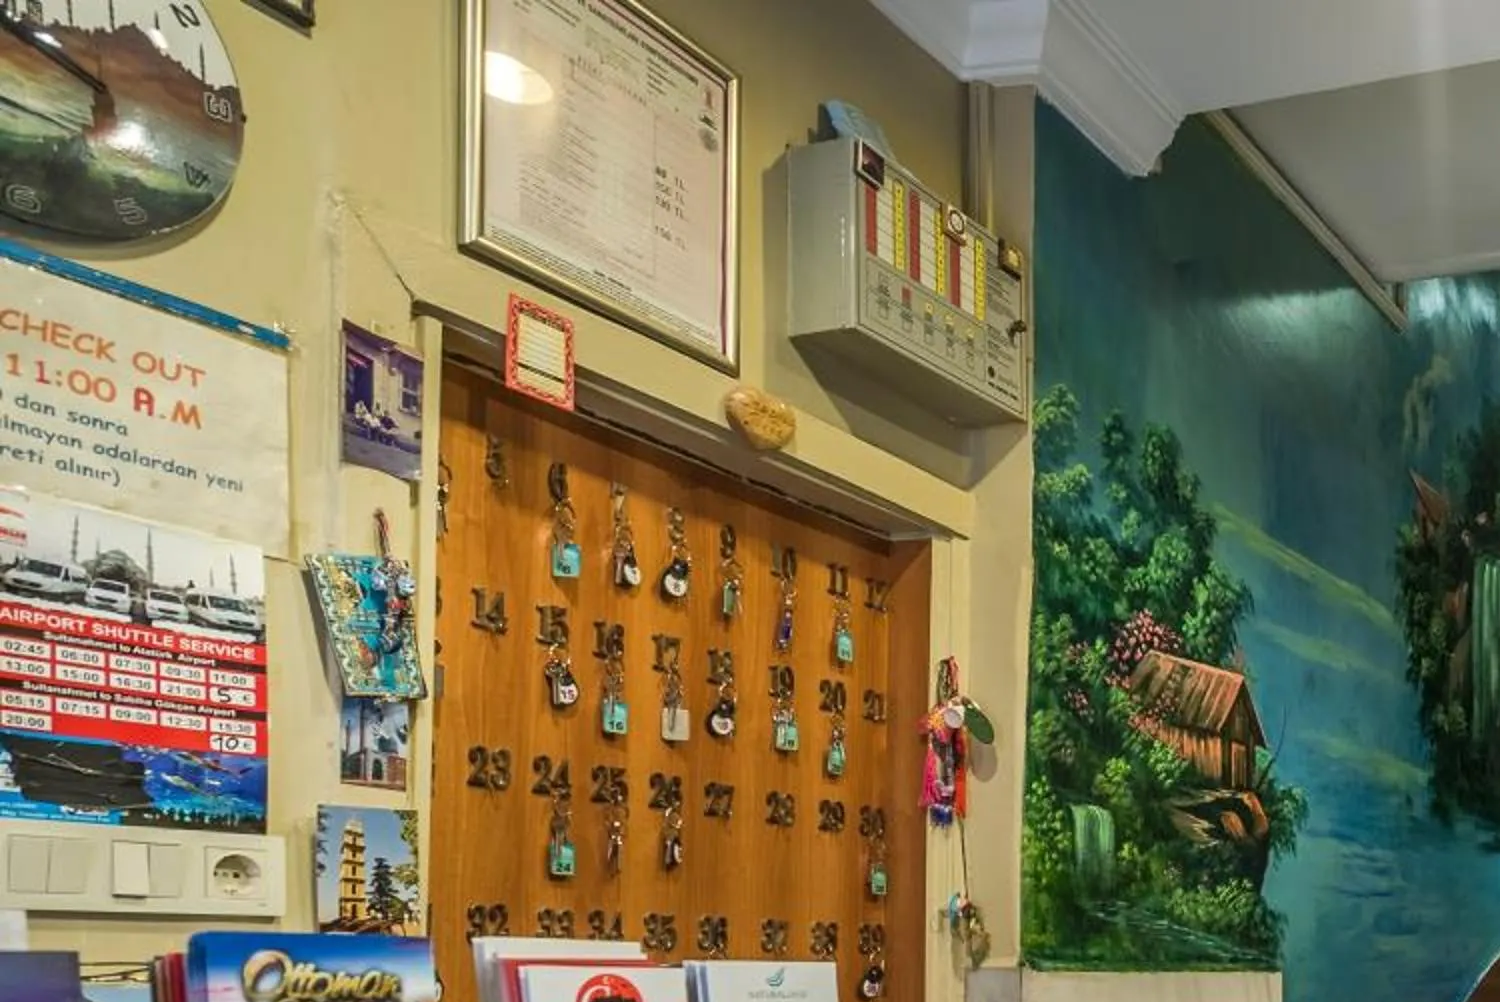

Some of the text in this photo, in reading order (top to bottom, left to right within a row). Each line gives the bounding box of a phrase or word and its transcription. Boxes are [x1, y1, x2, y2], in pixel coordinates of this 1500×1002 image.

[0, 309, 206, 387] CHECK OUT
[14, 394, 129, 437] dan sonra
[133, 387, 203, 430] A.M
[54, 456, 122, 487] alınır)
[93, 441, 198, 481] odalardan
[205, 471, 244, 493] yeni
[0, 606, 256, 661] AIRPORT SHUTTLE SERVICE
[178, 653, 216, 668] Airport
[197, 704, 237, 719] Airport
